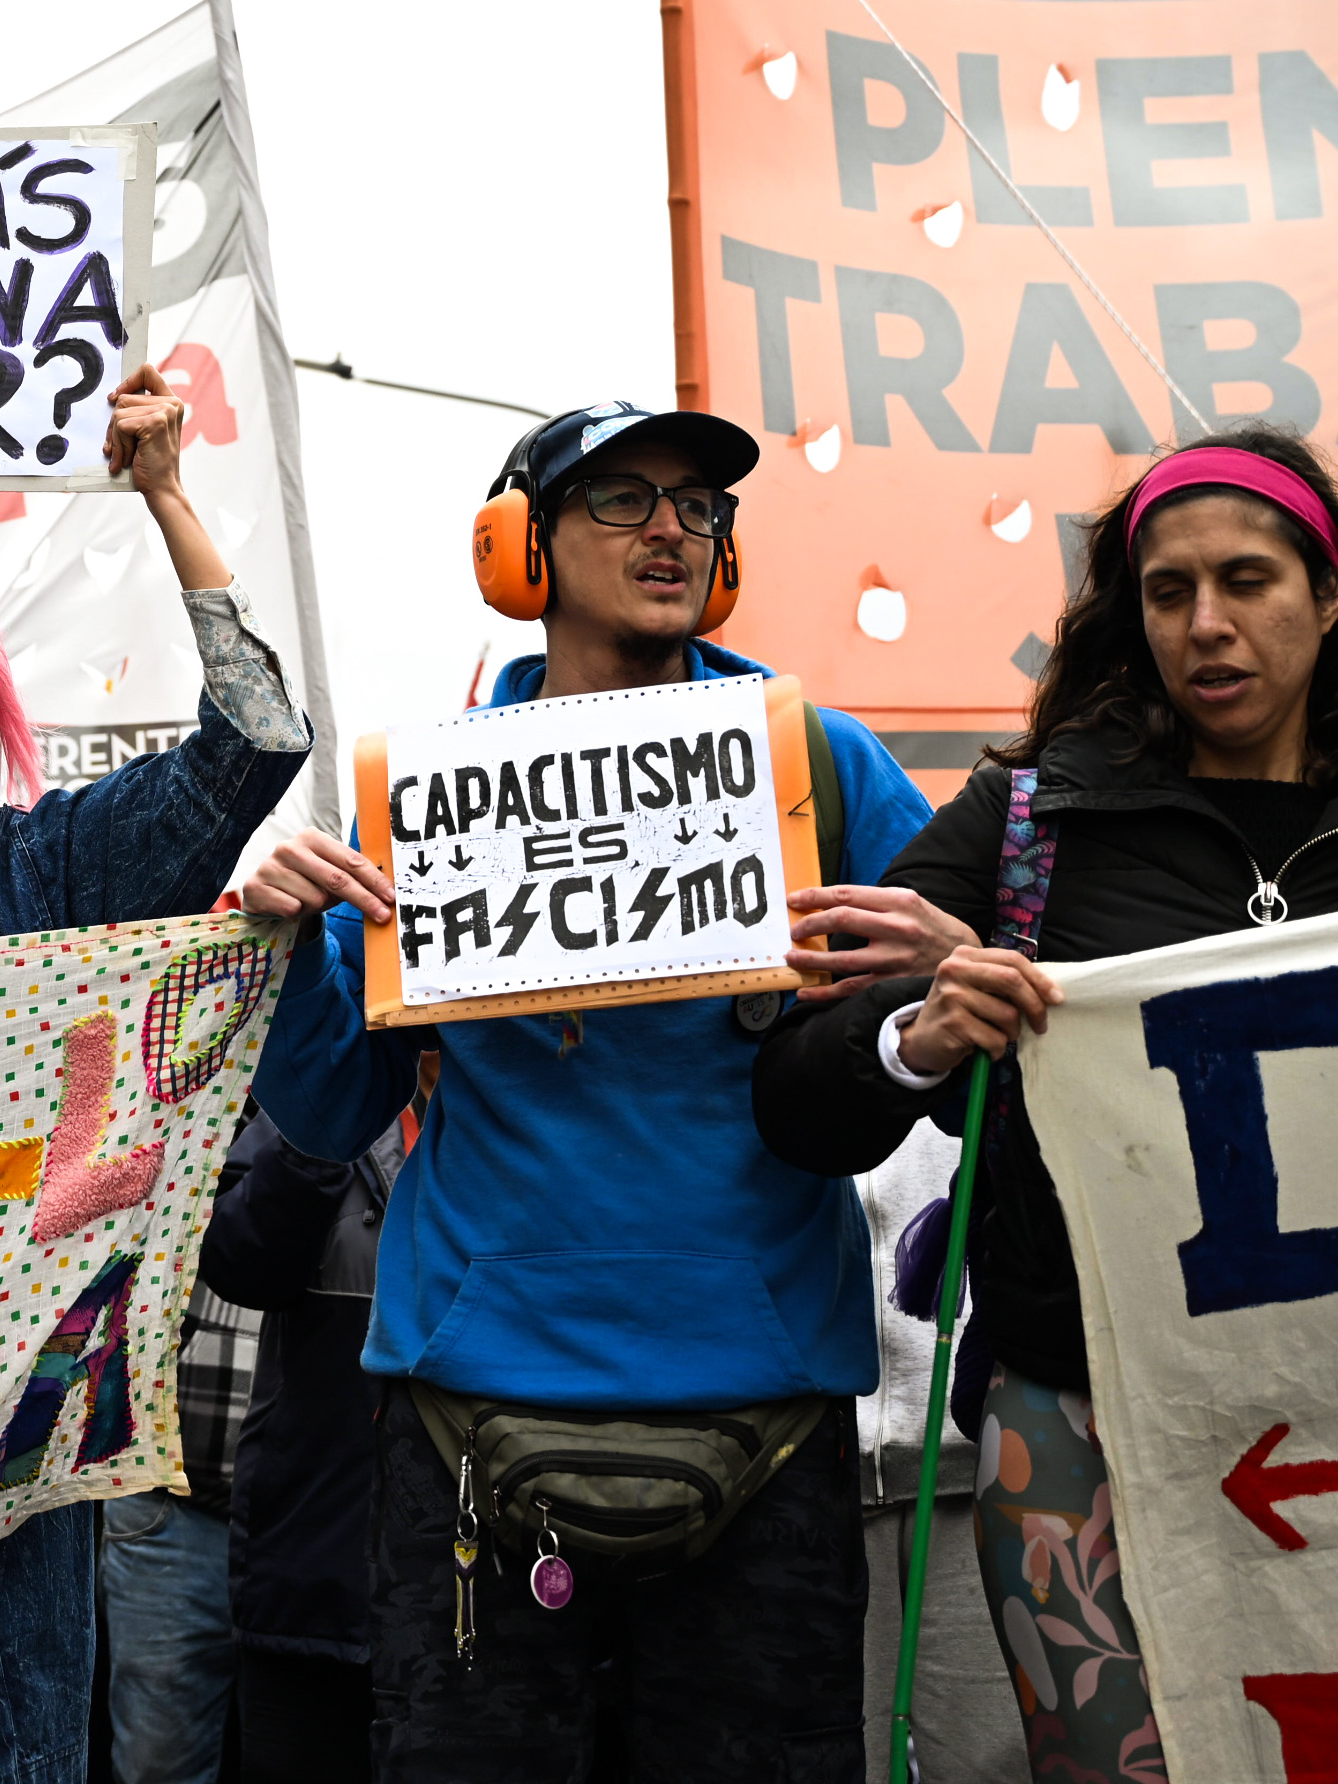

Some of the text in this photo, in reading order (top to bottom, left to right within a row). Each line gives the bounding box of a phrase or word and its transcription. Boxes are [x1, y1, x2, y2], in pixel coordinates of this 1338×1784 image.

[32, 250, 129, 349] A
[720, 234, 1338, 455] TRAB
[388, 726, 756, 843] CAPACITISMO
[523, 821, 629, 873] ES
